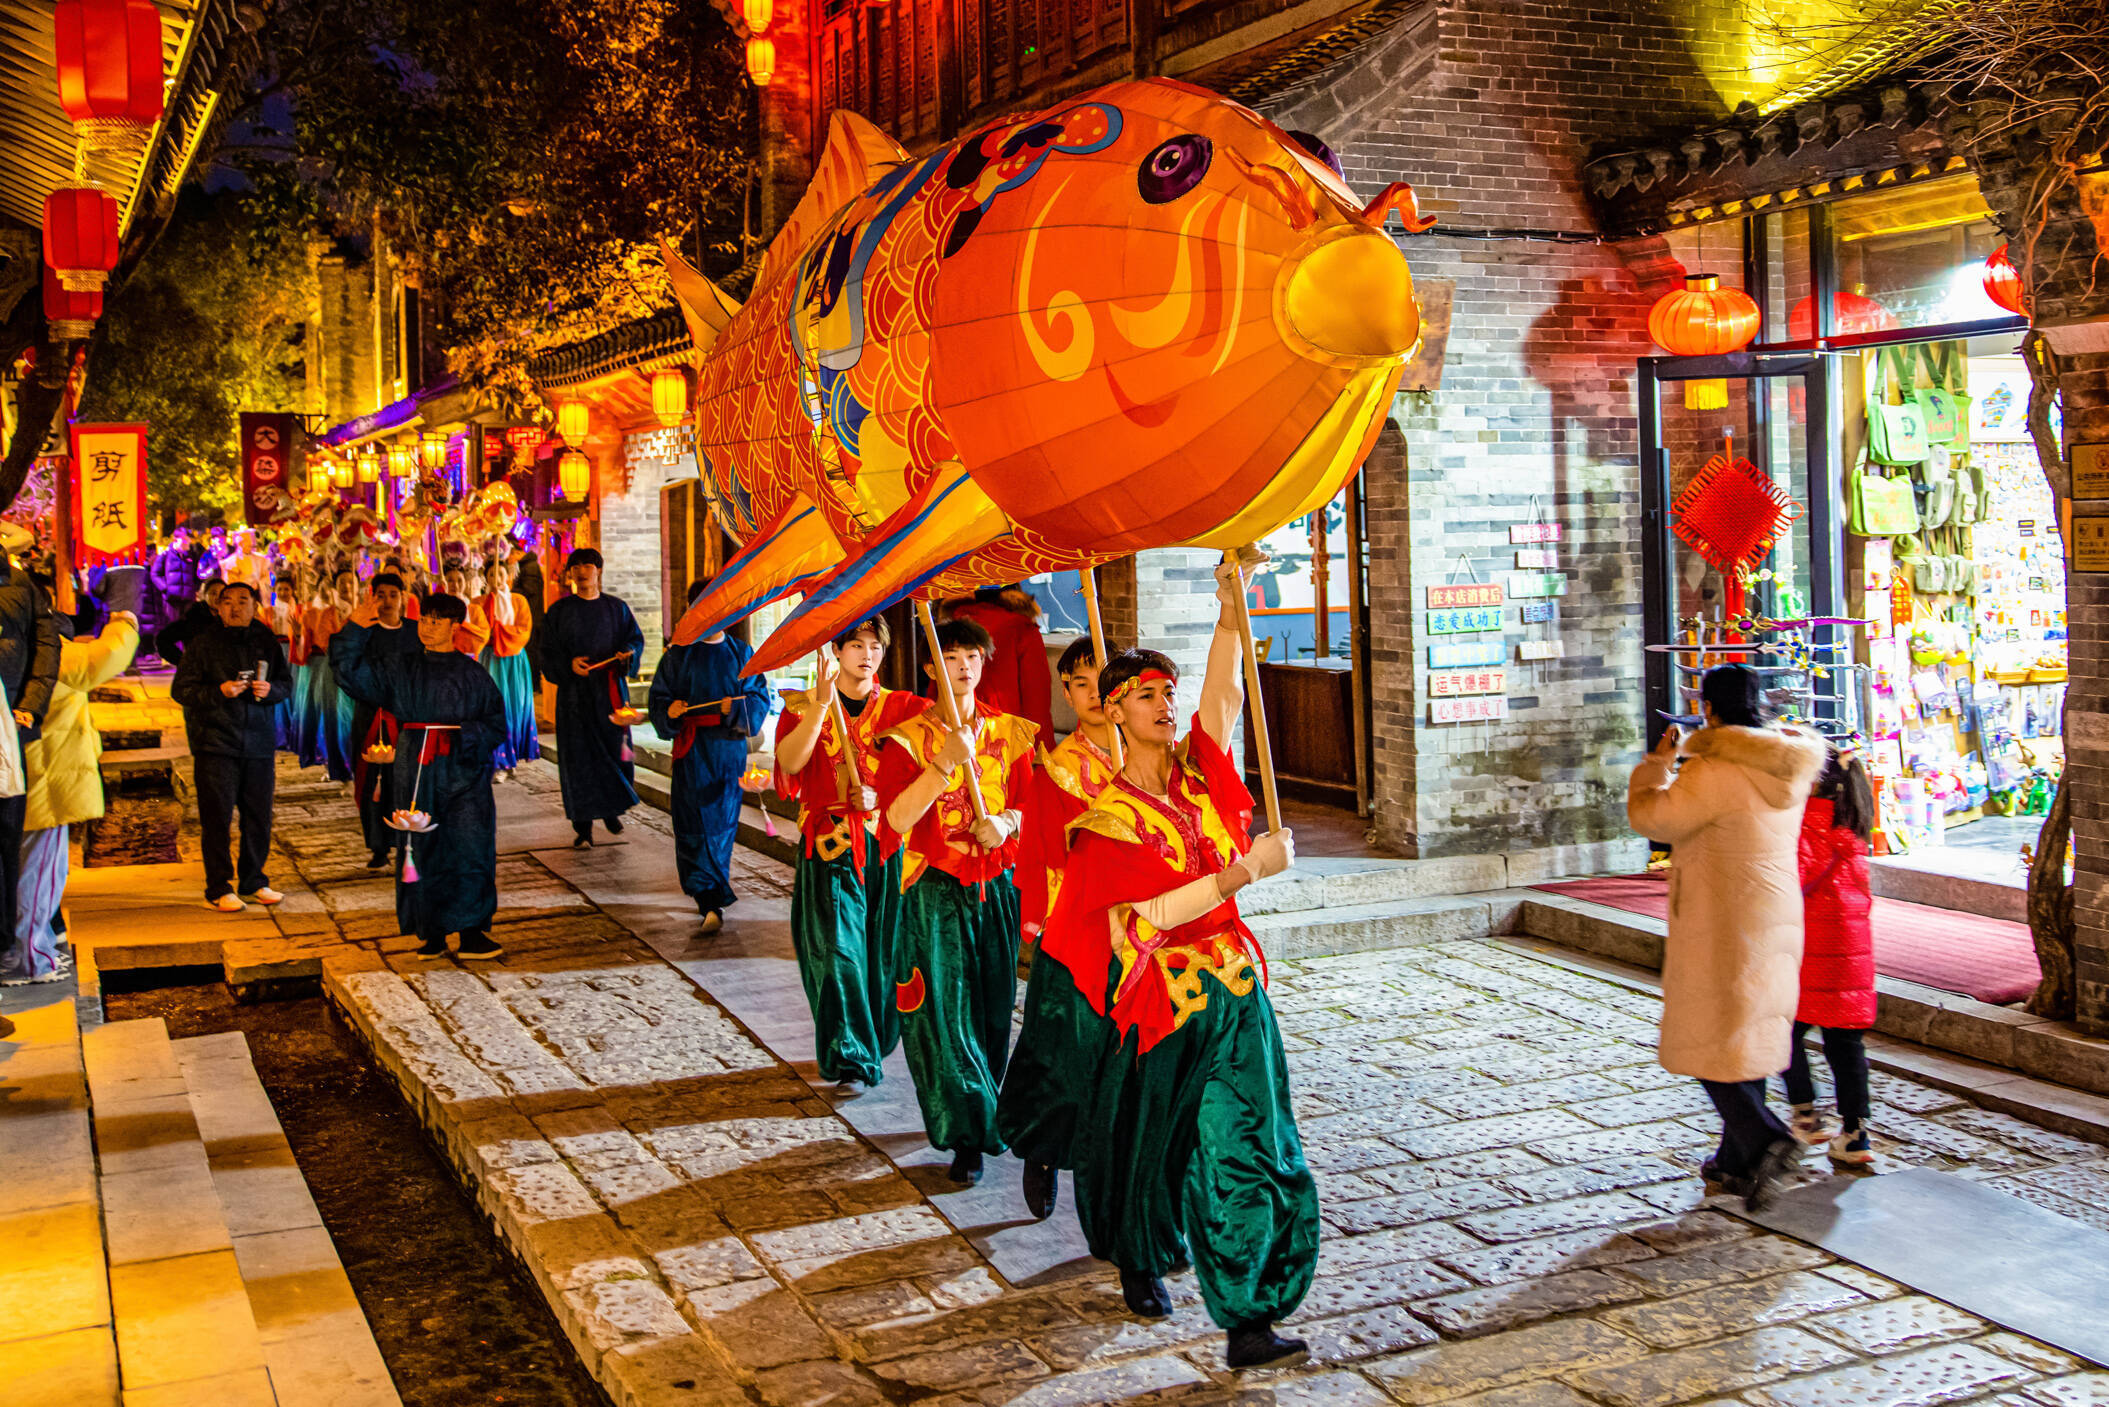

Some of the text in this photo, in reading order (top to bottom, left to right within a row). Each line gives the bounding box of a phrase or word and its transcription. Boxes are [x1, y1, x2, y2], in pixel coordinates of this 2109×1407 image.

[1432, 588, 1502, 606] 在本店消费后
[1433, 610, 1502, 631] 恋爱成功了
[1435, 673, 1504, 694] 运气爆棚了
[1437, 698, 1503, 720] 心想事成了
